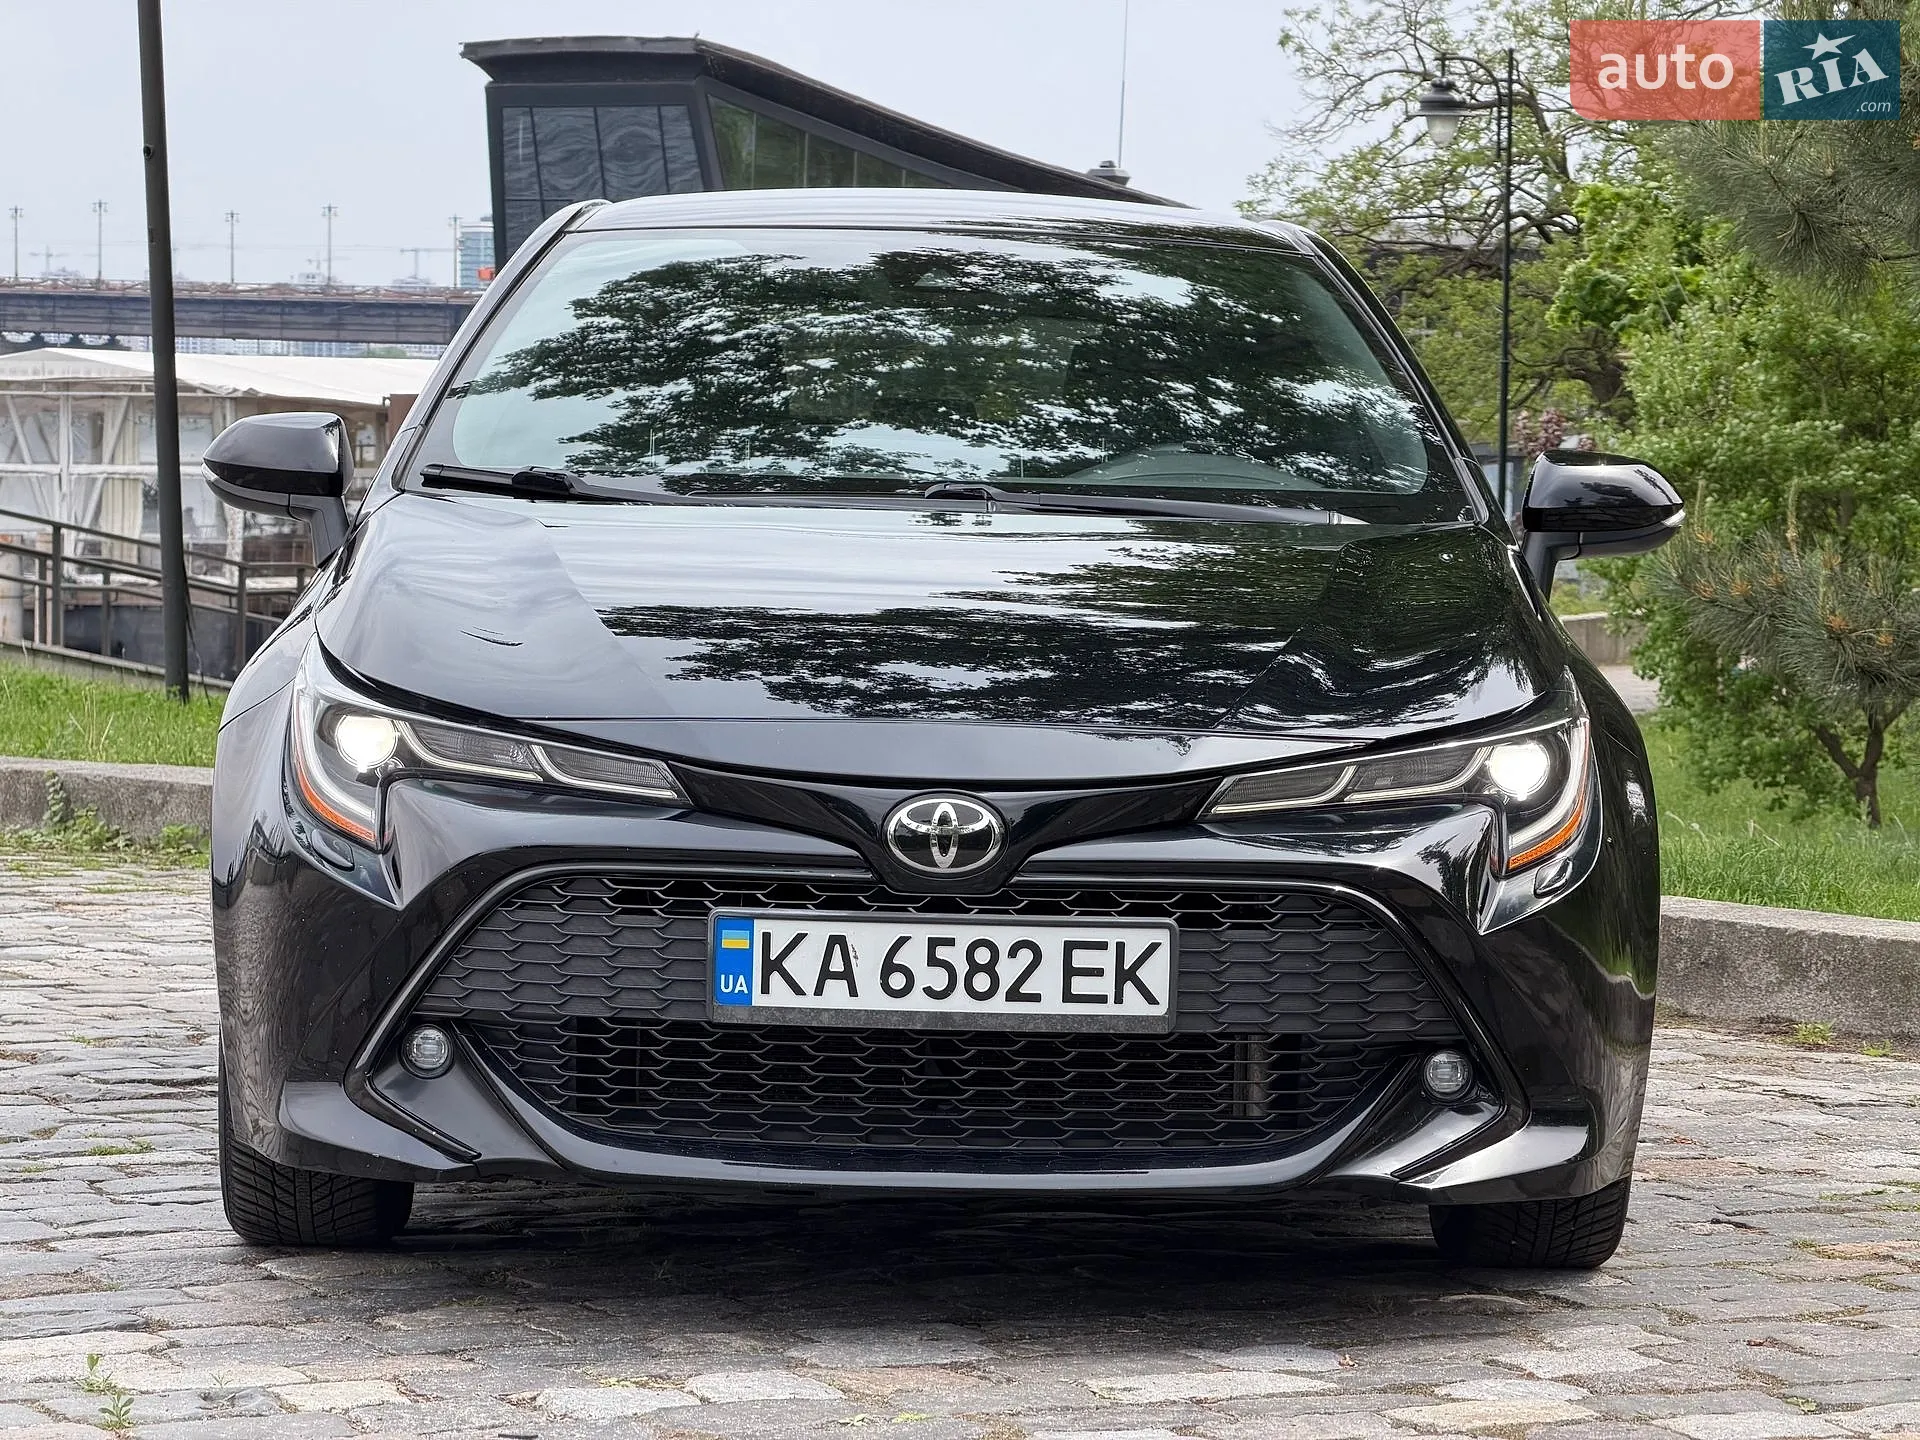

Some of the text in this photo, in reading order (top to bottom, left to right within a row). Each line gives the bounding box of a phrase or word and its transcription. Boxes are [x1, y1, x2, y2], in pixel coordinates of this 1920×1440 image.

[720, 974, 748, 995] UA
[760, 931, 1163, 1005] KA 6582 EK
